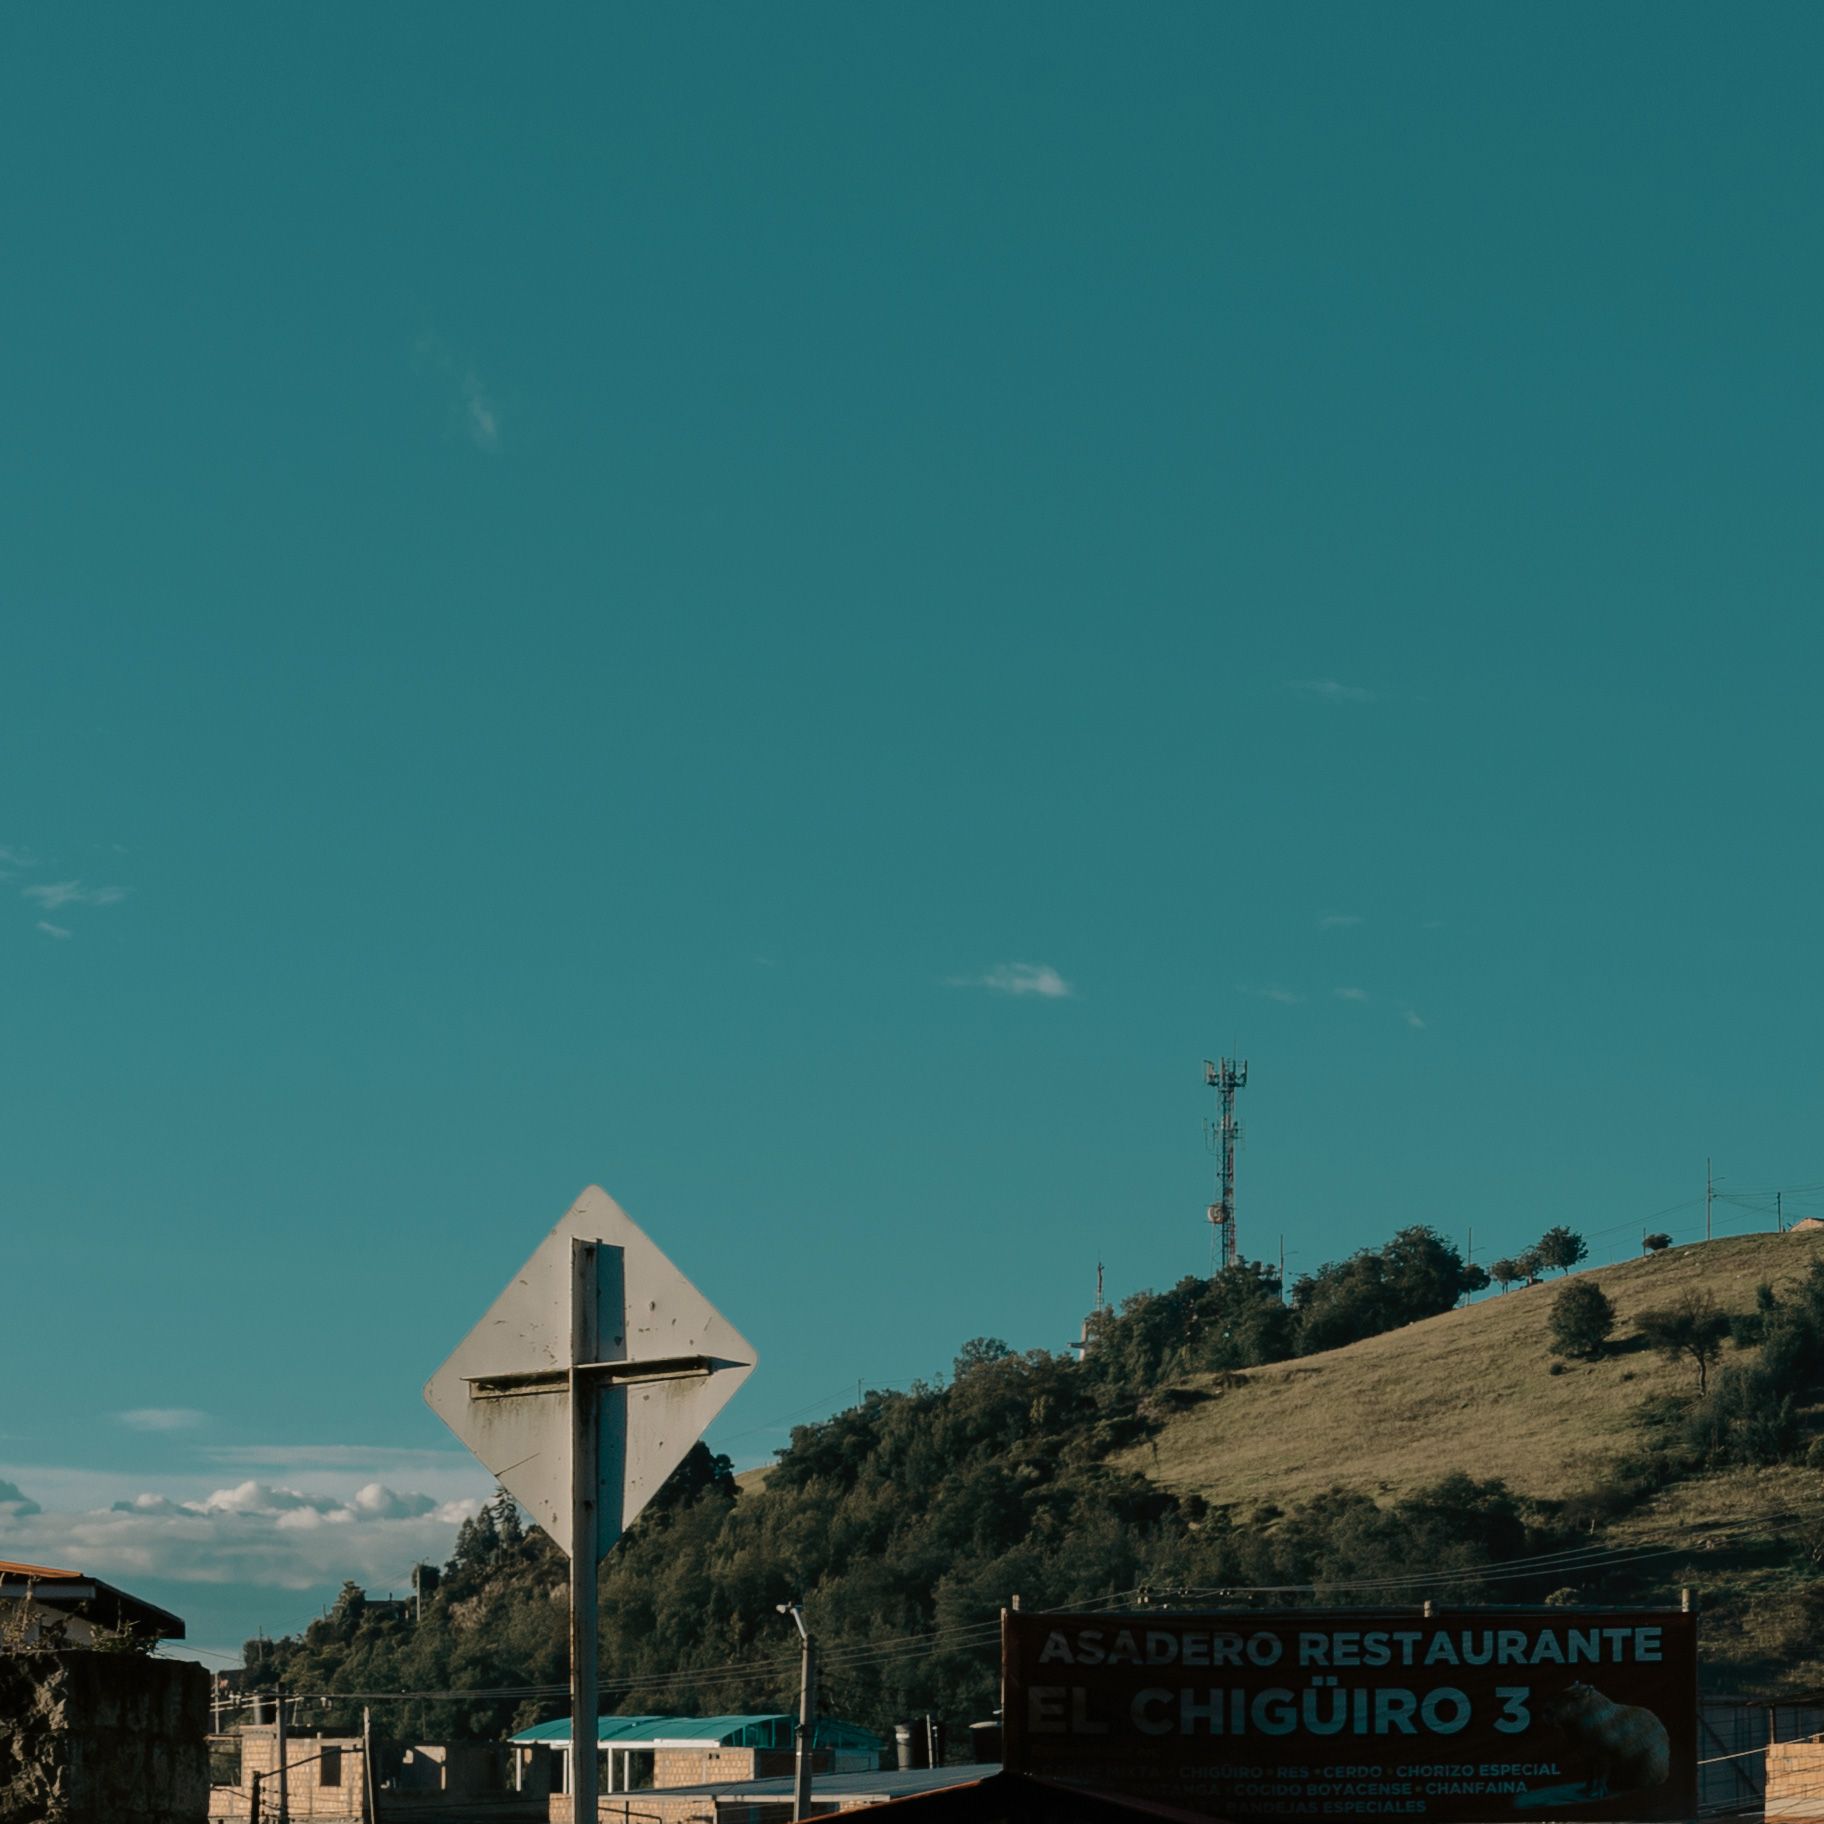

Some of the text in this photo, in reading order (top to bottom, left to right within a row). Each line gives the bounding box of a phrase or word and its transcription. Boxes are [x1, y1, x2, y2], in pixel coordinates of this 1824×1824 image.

[1038, 1626, 1664, 1668] ASADERO RESTAURANTE
[1027, 1675, 1533, 1737] EL CHIGÜIRO 3
[1179, 1761, 1264, 1779] CHIGÜIRO
[1276, 1765, 1310, 1779] RES
[1323, 1765, 1383, 1779] CERDO
[1395, 1763, 1475, 1778] CHORIZO
[1479, 1762, 1562, 1777] ESPECIAL
[1233, 1784, 1303, 1798] COCIDO
[1306, 1782, 1413, 1798] BOYACENSE
[1425, 1781, 1529, 1796] CHANFAINA
[1226, 1800, 1319, 1815] BANDEJAS
[1323, 1800, 1427, 1814] ESPECIALES
